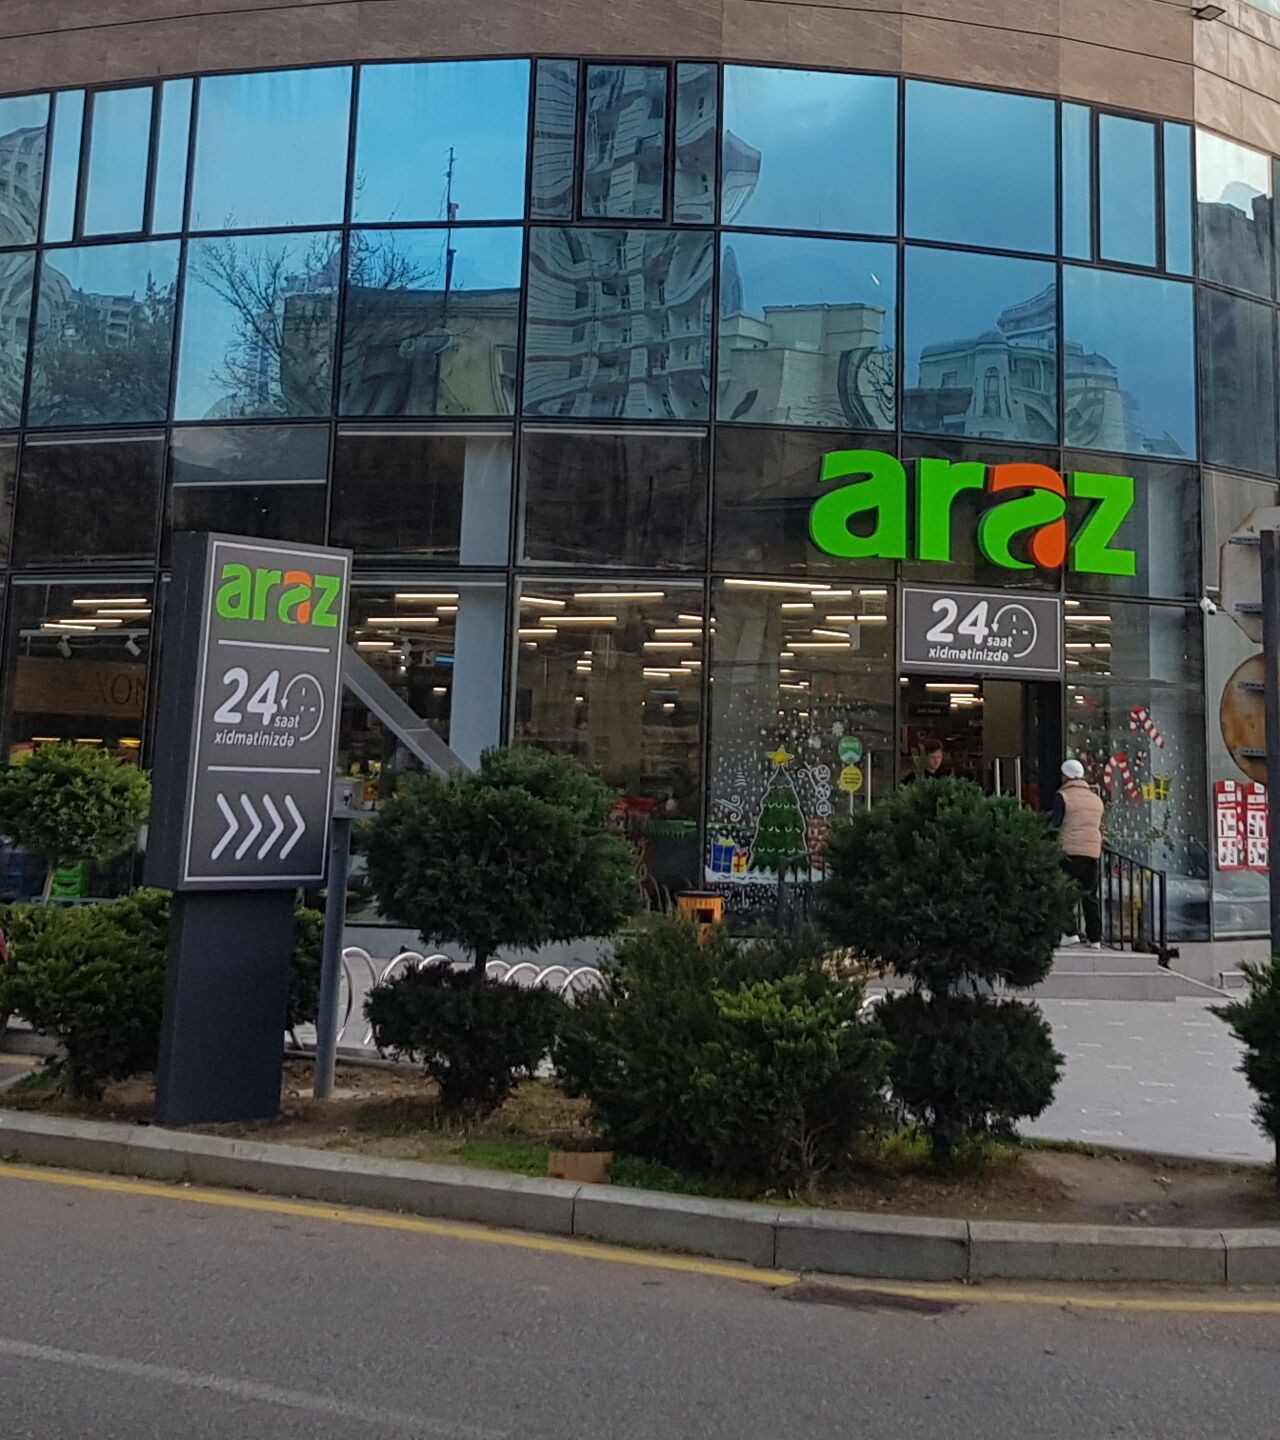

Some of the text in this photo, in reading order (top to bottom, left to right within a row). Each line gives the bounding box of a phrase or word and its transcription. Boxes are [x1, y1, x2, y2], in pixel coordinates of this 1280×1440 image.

[809, 449, 1136, 576] araz
[215, 563, 341, 628] araz
[926, 597, 1013, 649] 24 saat
[928, 645, 1009, 662] xidmətinizdə
[213, 667, 301, 729] 24 saat
[213, 729, 296, 747] xidmətinizdə
